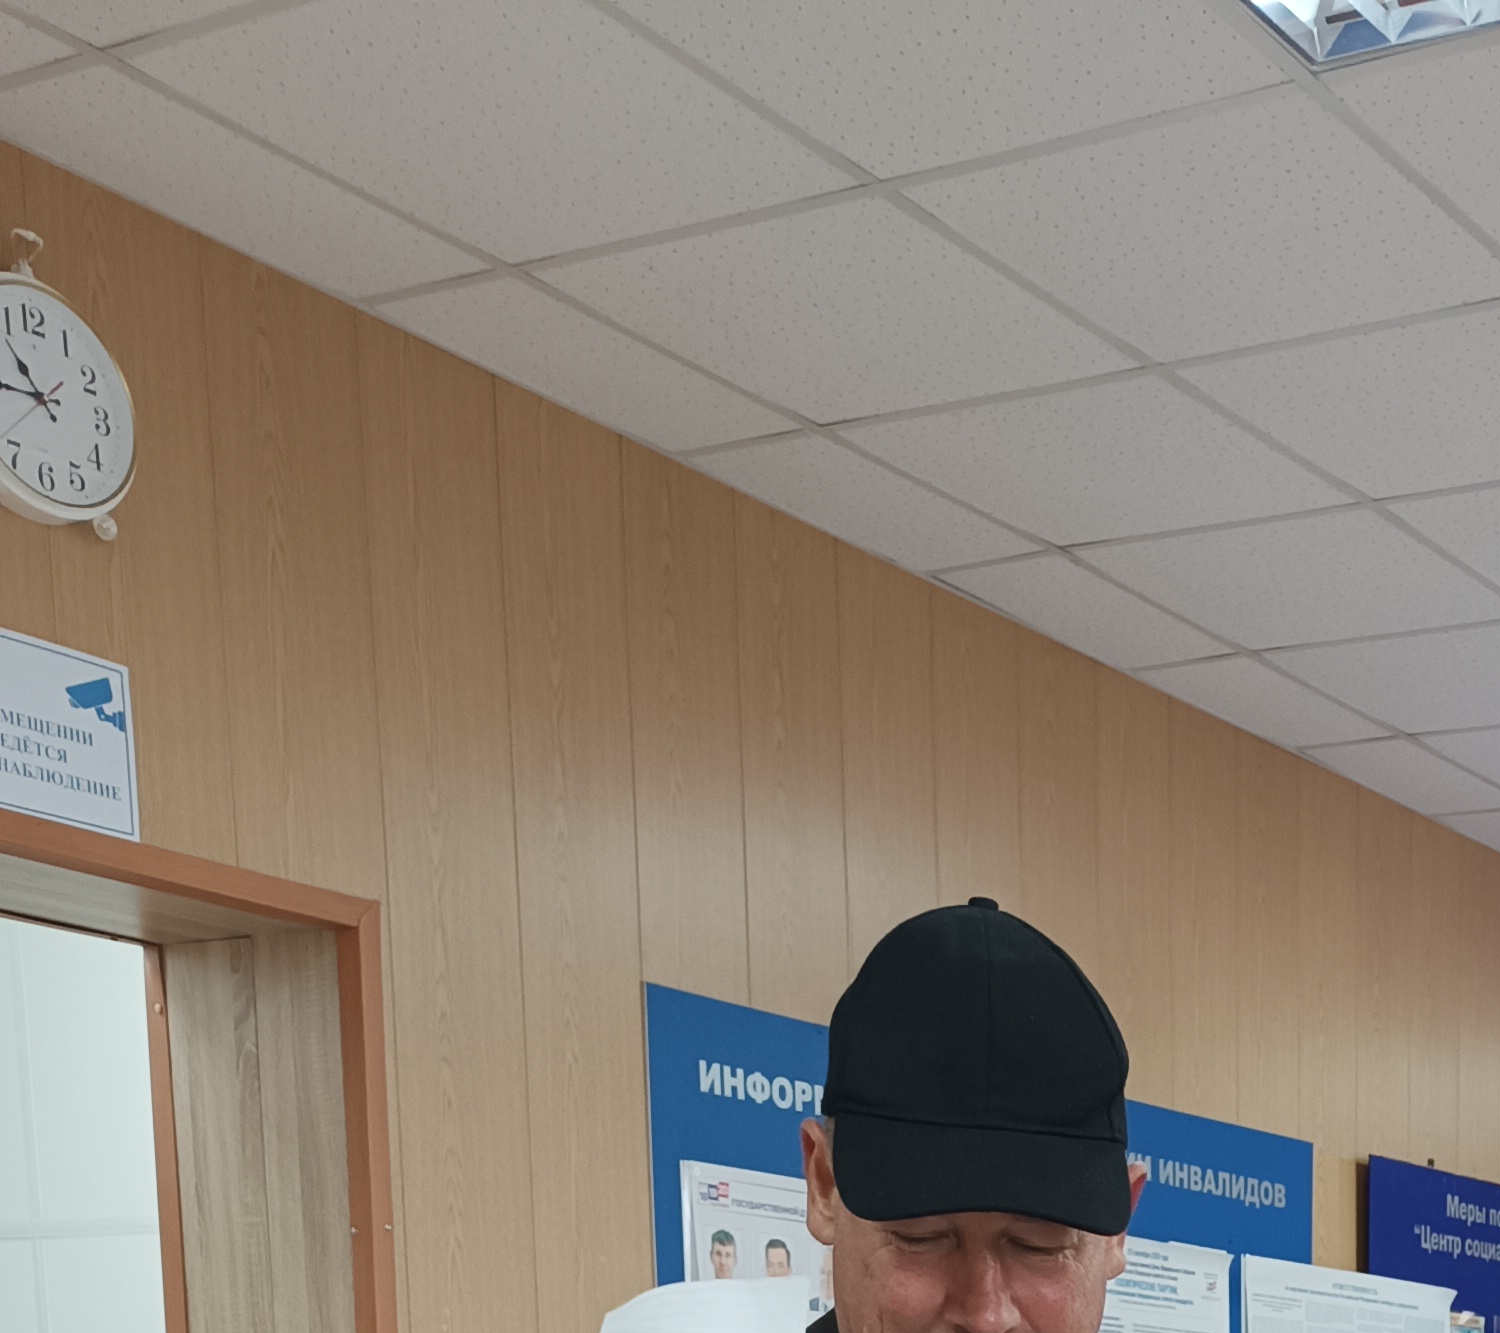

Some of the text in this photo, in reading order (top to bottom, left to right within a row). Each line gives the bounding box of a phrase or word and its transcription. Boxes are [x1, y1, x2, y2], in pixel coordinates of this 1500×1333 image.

[21, 302, 46, 339] 12
[61, 328, 71, 359] 1
[80, 364, 97, 397] 2
[93, 405, 111, 437] 3
[6, 438, 21, 470] 7
[86, 443, 104, 472] 4
[37, 461, 56, 492] 6
[68, 460, 86, 492] 5
[1158, 1158, 1287, 1209] ИНВАЛИДОВ
[1446, 1193, 1486, 1227] Меры
